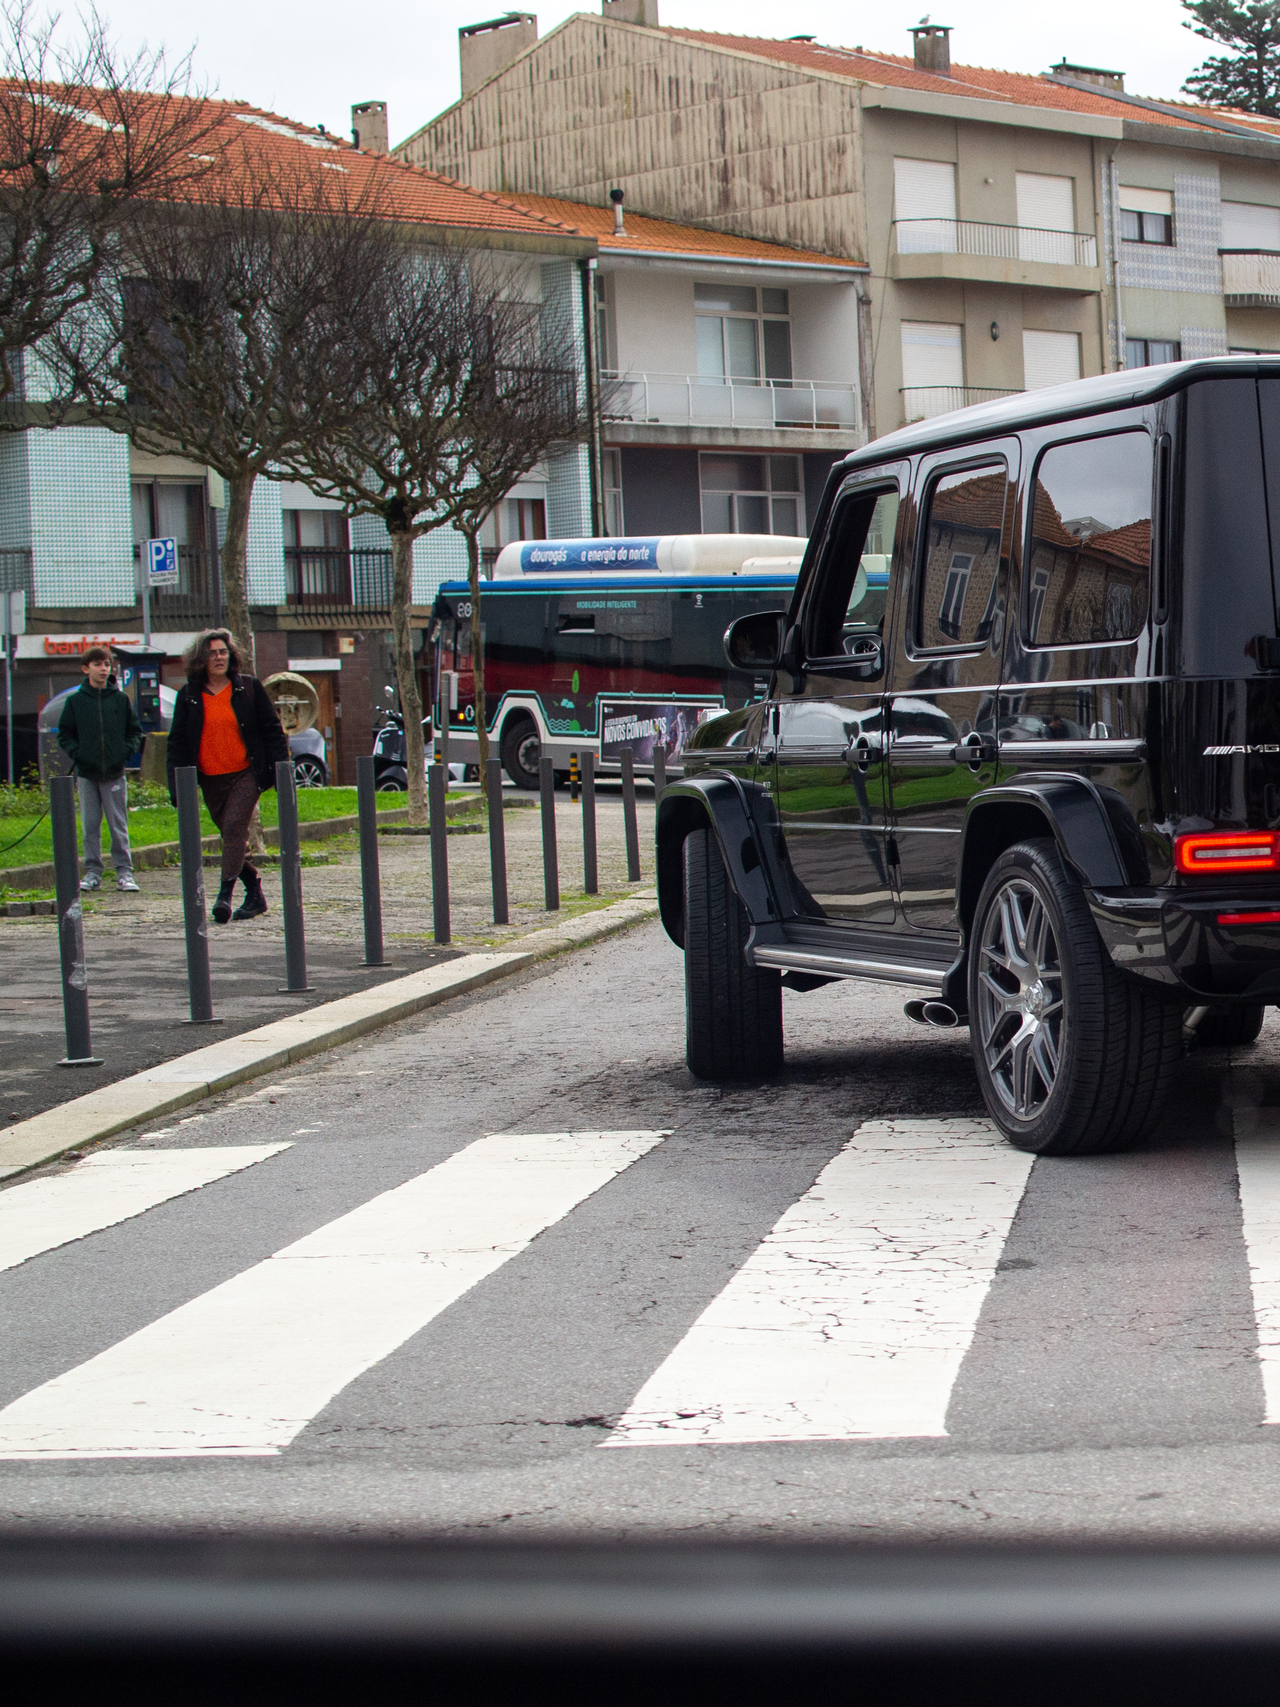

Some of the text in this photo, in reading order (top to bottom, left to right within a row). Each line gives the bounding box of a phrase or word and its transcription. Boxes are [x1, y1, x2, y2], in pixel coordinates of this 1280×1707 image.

[151, 541, 165, 571] P
[581, 551, 586, 561] a
[587, 547, 615, 564] energia
[617, 547, 627, 561] do
[629, 546, 649, 560] norte
[577, 600, 637, 609] MOBILIDADE INTELIGENTE
[123, 669, 131, 684] P
[604, 723, 626, 744] NOVOS
[1228, 744, 1280, 754] AMG
